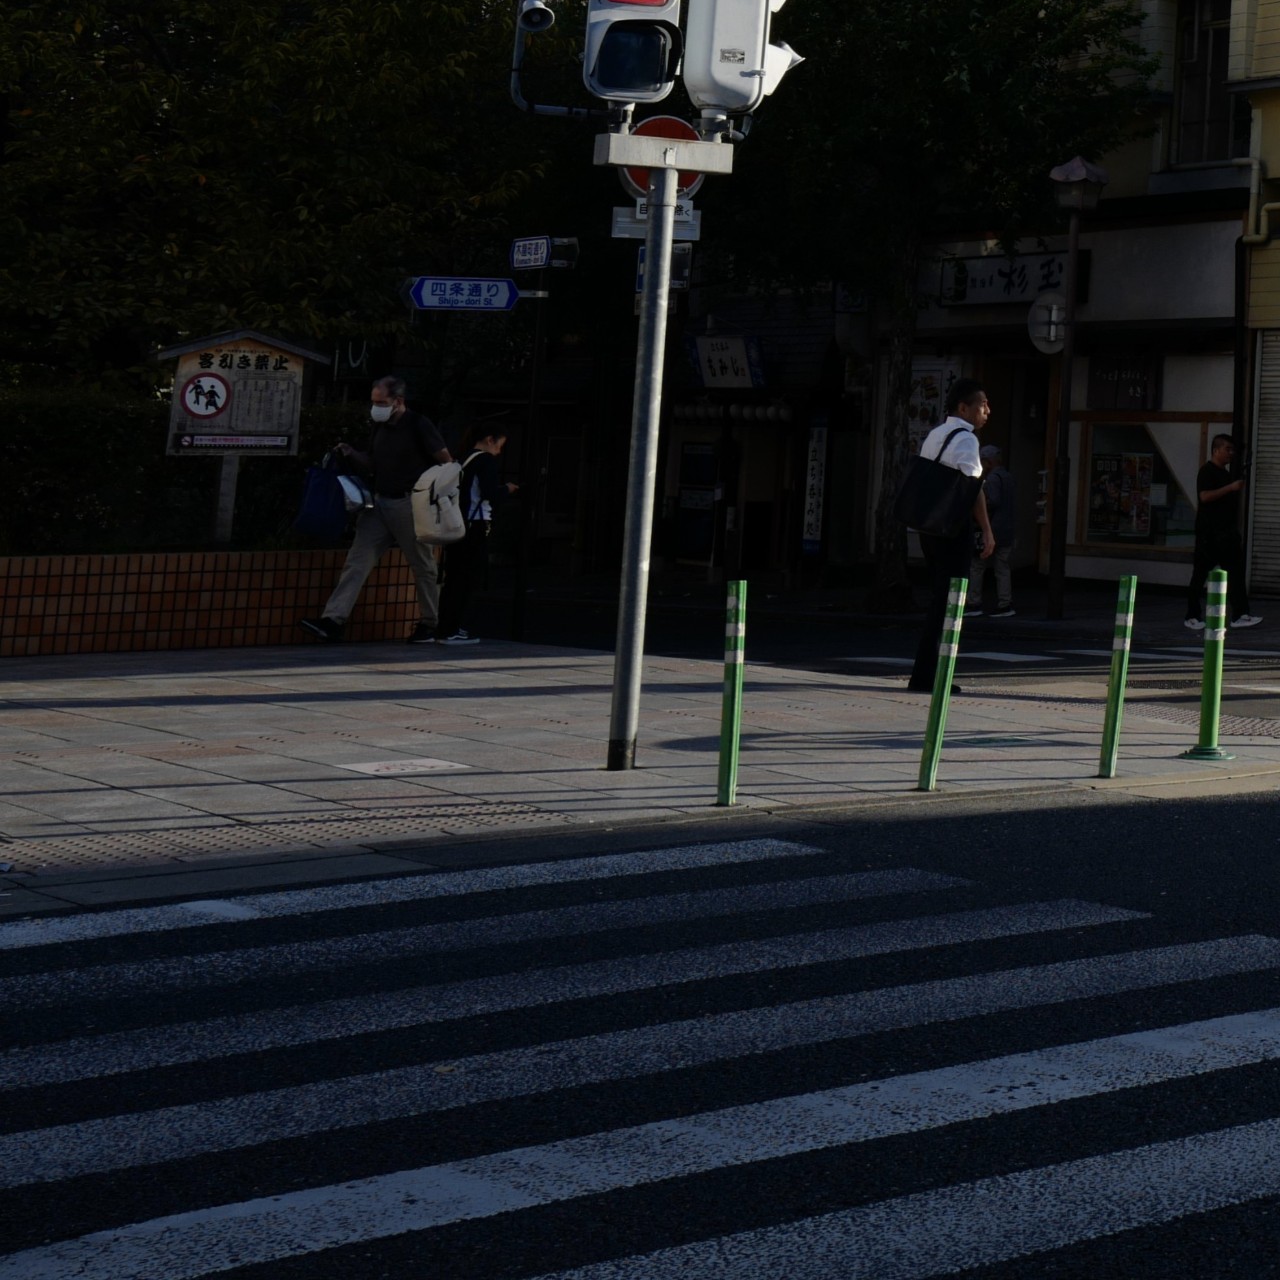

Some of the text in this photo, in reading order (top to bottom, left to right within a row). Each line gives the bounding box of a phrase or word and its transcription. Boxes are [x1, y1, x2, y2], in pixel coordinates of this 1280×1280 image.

[998, 257, 1063, 295] 杉玉
[431, 282, 499, 297] 四条通り
[199, 353, 290, 370] 客引き禁止
